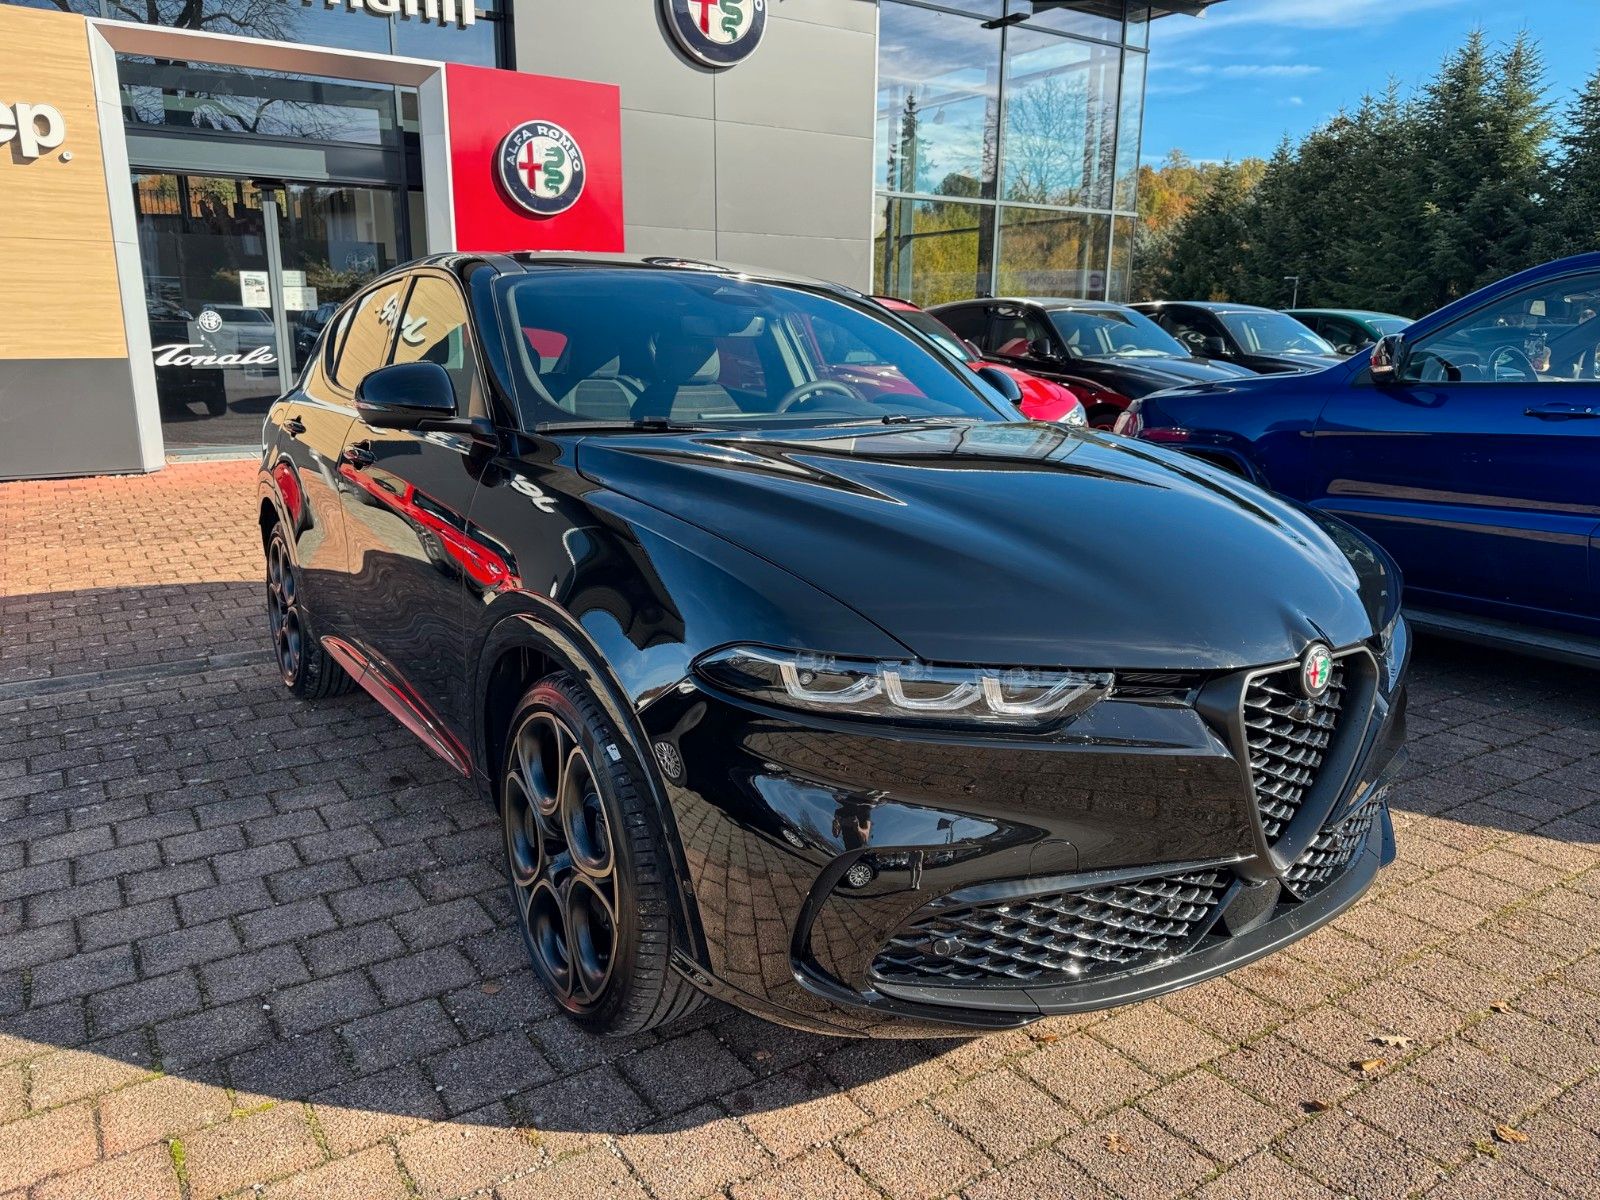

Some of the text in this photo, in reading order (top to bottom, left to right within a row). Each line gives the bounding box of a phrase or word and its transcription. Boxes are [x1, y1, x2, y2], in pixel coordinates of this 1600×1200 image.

[506, 125, 581, 172] ALFA ROMEO
[152, 344, 278, 366] Tonale
